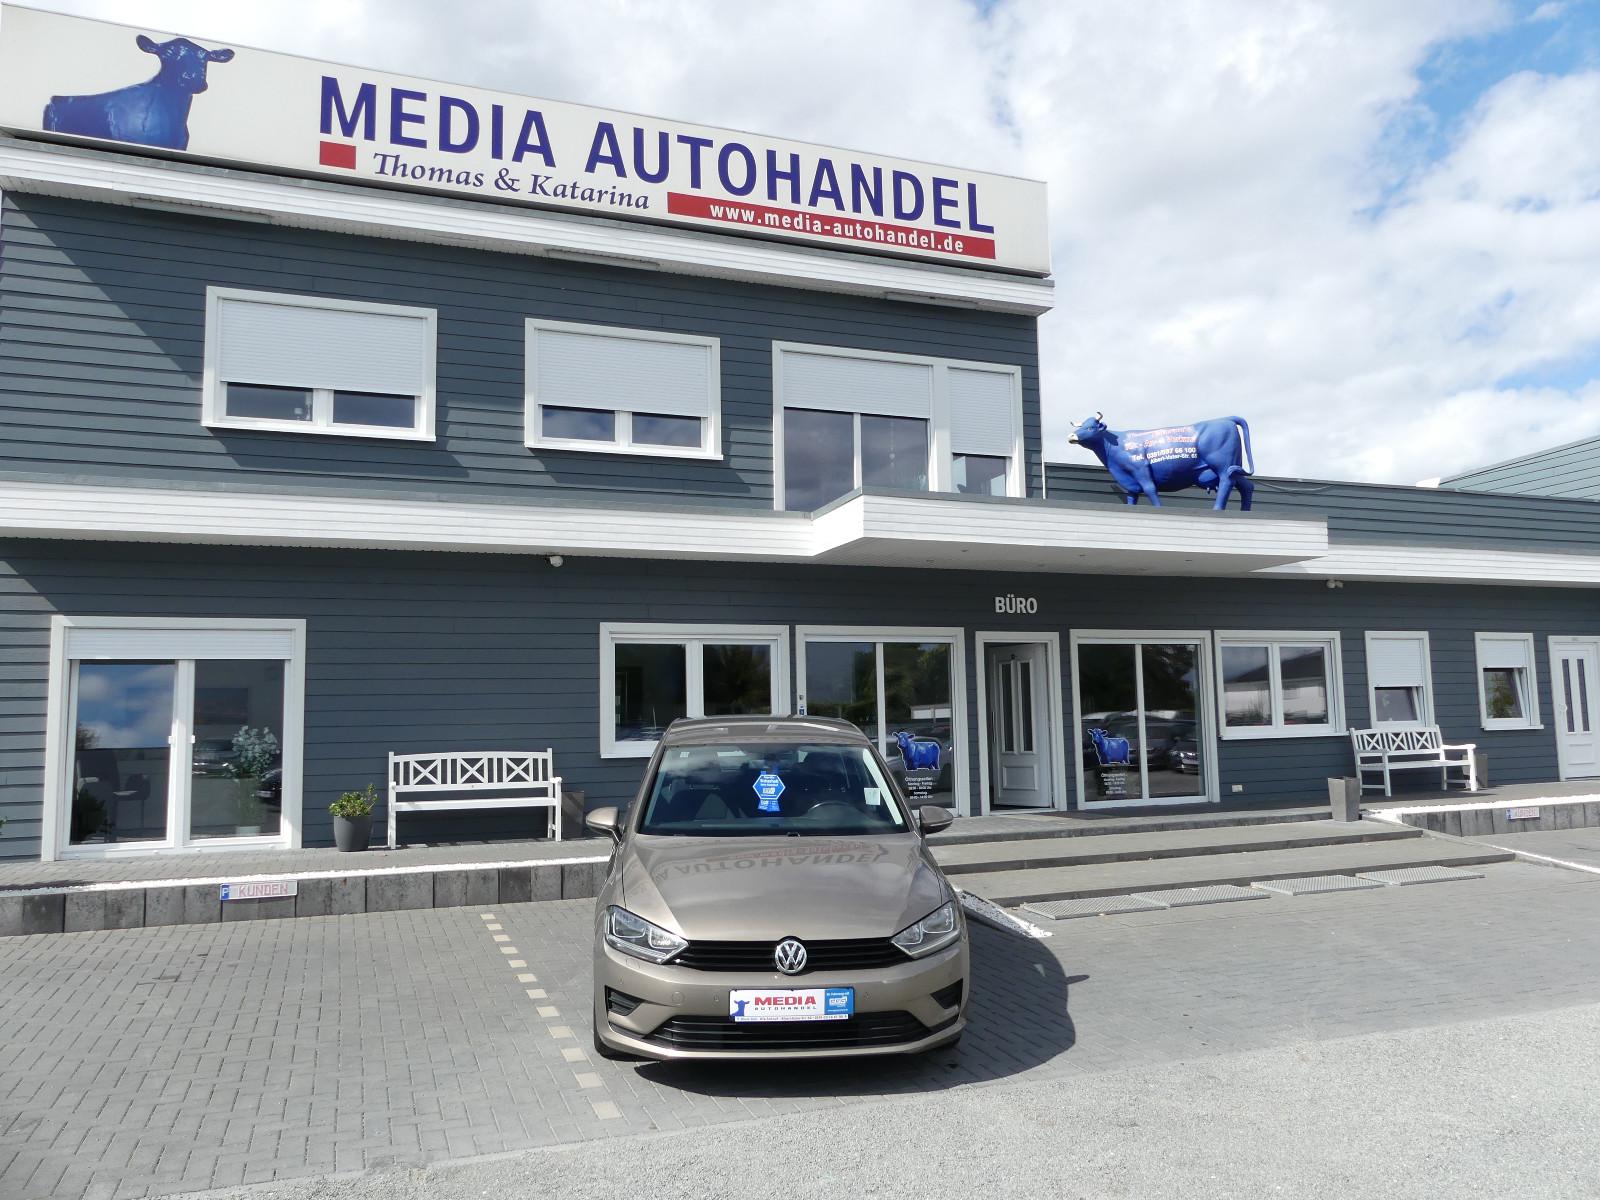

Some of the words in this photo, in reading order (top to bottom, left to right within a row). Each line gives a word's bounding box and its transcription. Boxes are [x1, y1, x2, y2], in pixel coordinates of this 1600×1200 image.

[320, 75, 556, 168] MEDIA
[584, 121, 995, 234] AUTOHANDEL
[373, 152, 485, 188] Thomas
[494, 167, 520, 193] &
[528, 173, 650, 210] Katarina
[709, 204, 964, 253] www.media-autohandel.de
[994, 593, 1038, 614] BÜRO
[239, 883, 288, 897] KUNDEN
[754, 996, 817, 1006] MEDIA
